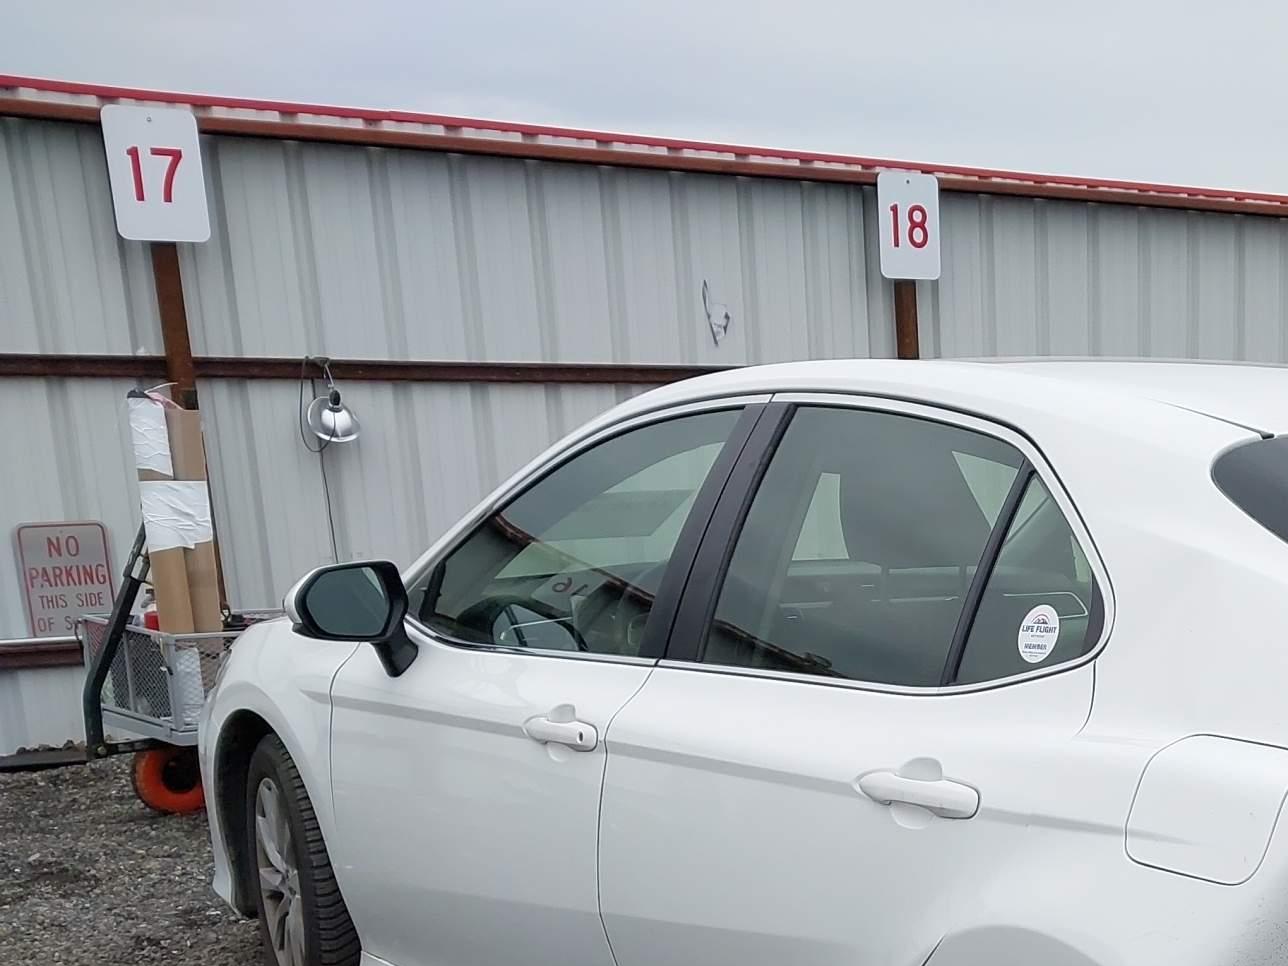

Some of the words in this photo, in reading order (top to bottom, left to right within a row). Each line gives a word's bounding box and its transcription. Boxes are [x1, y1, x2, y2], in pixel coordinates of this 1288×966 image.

[127, 145, 184, 204] 17
[890, 203, 929, 250] 18
[46, 535, 80, 558] NO
[28, 563, 107, 589] PARKING
[38, 594, 68, 610] THIS
[76, 592, 105, 607] SIDE
[37, 617, 55, 632] OF
[1021, 625, 1035, 633] LIFE
[1036, 625, 1057, 634] FLIGHT
